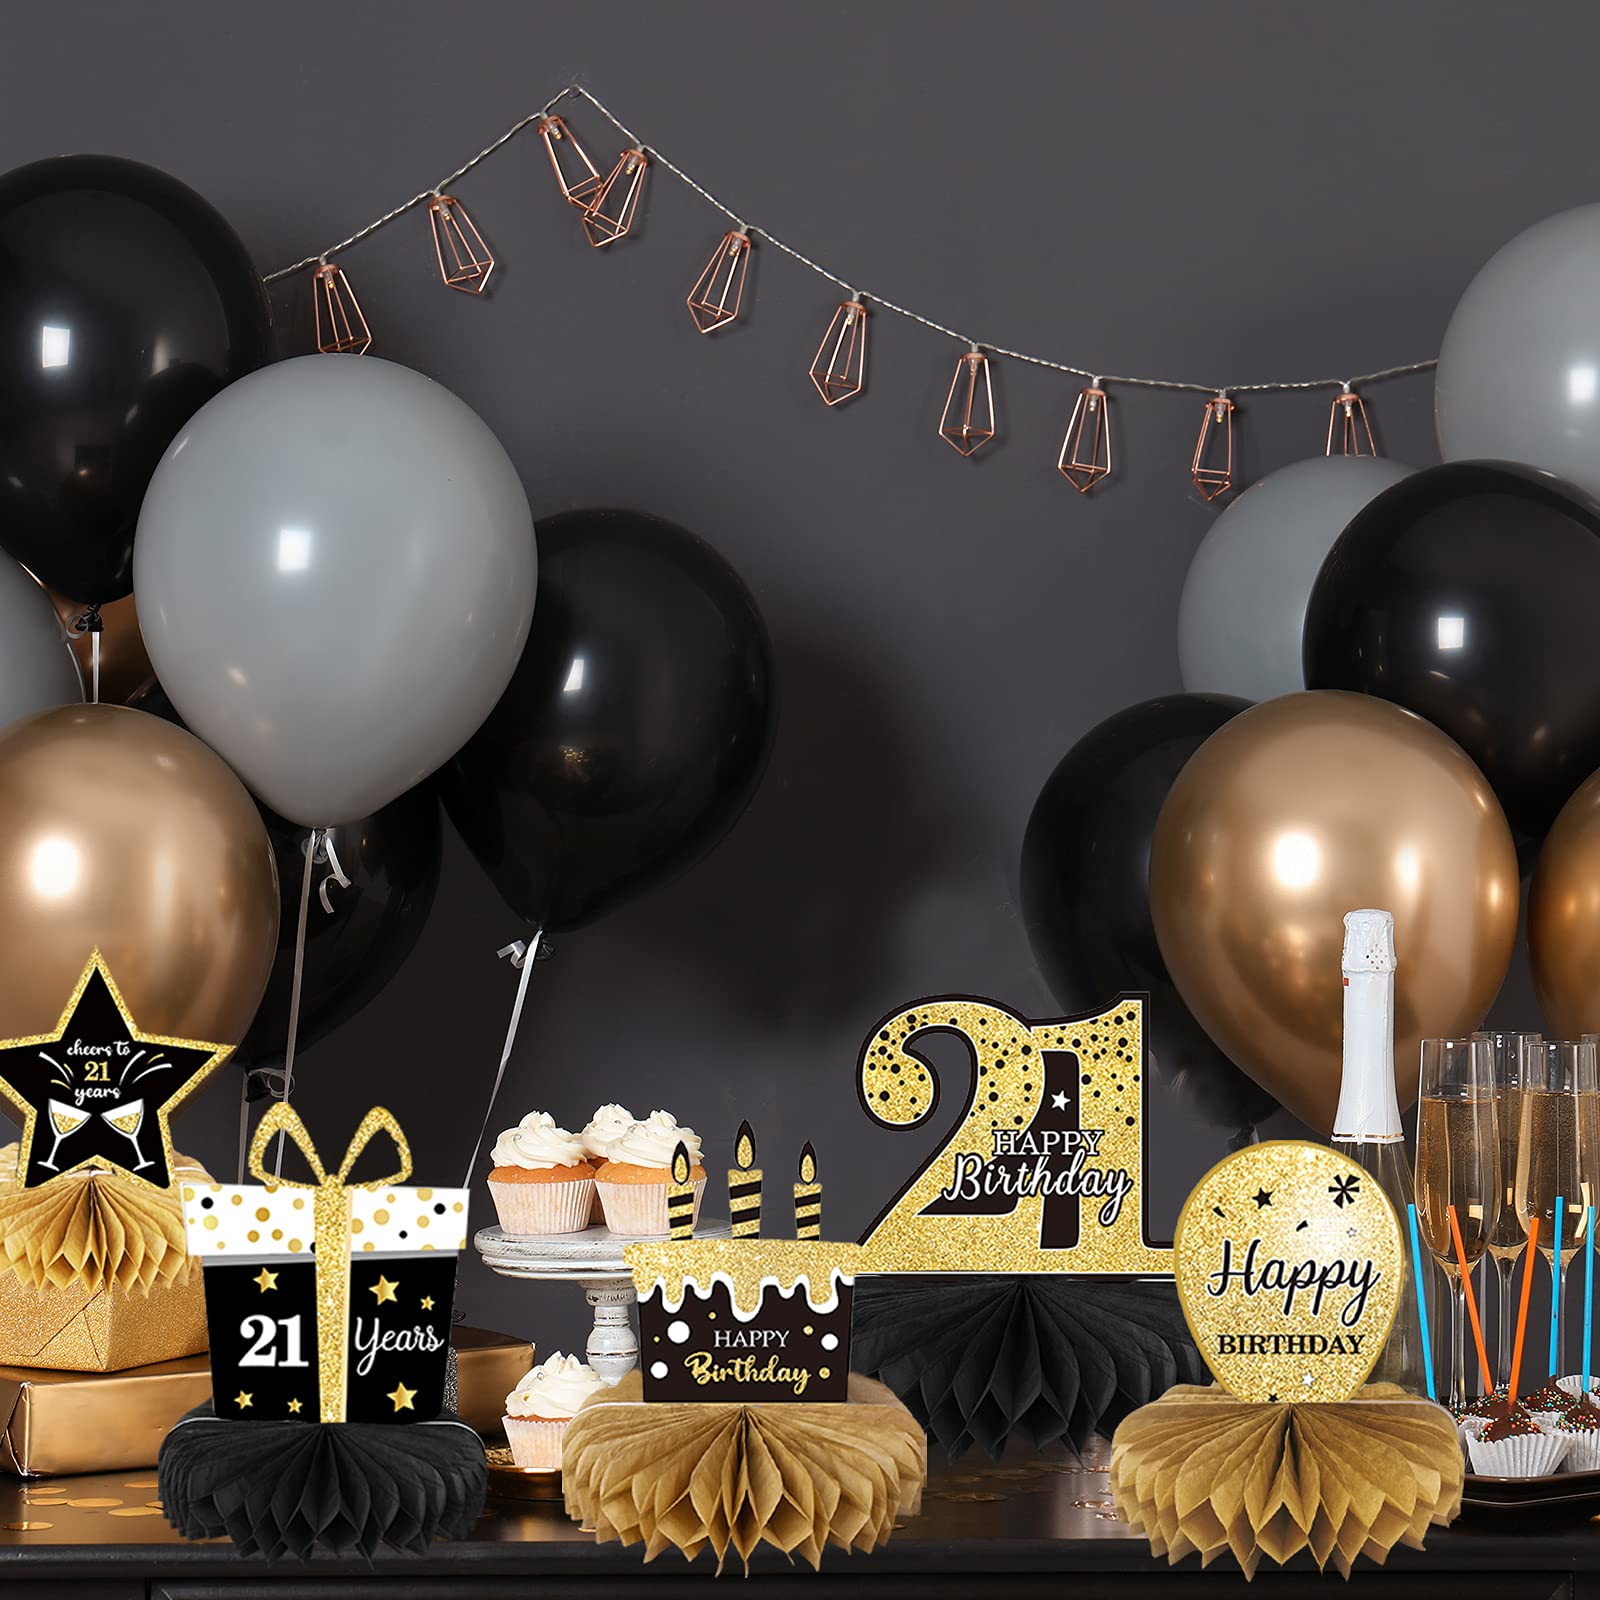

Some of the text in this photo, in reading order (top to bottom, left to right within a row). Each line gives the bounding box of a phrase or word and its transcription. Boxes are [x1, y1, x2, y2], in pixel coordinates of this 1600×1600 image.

[66, 1038, 130, 1056] cheers to
[83, 1061, 110, 1082] 21
[74, 1086, 121, 1106] years
[857, 993, 1174, 1277] 21
[992, 1129, 1105, 1157] HAPPY
[941, 1146, 1133, 1226] Birthday
[1207, 1239, 1381, 1326] Happy
[238, 1314, 445, 1376] 21 Years
[713, 1329, 790, 1349] HAPPY
[1218, 1334, 1366, 1355] BIRTHDAY
[683, 1351, 812, 1396] Birthday
